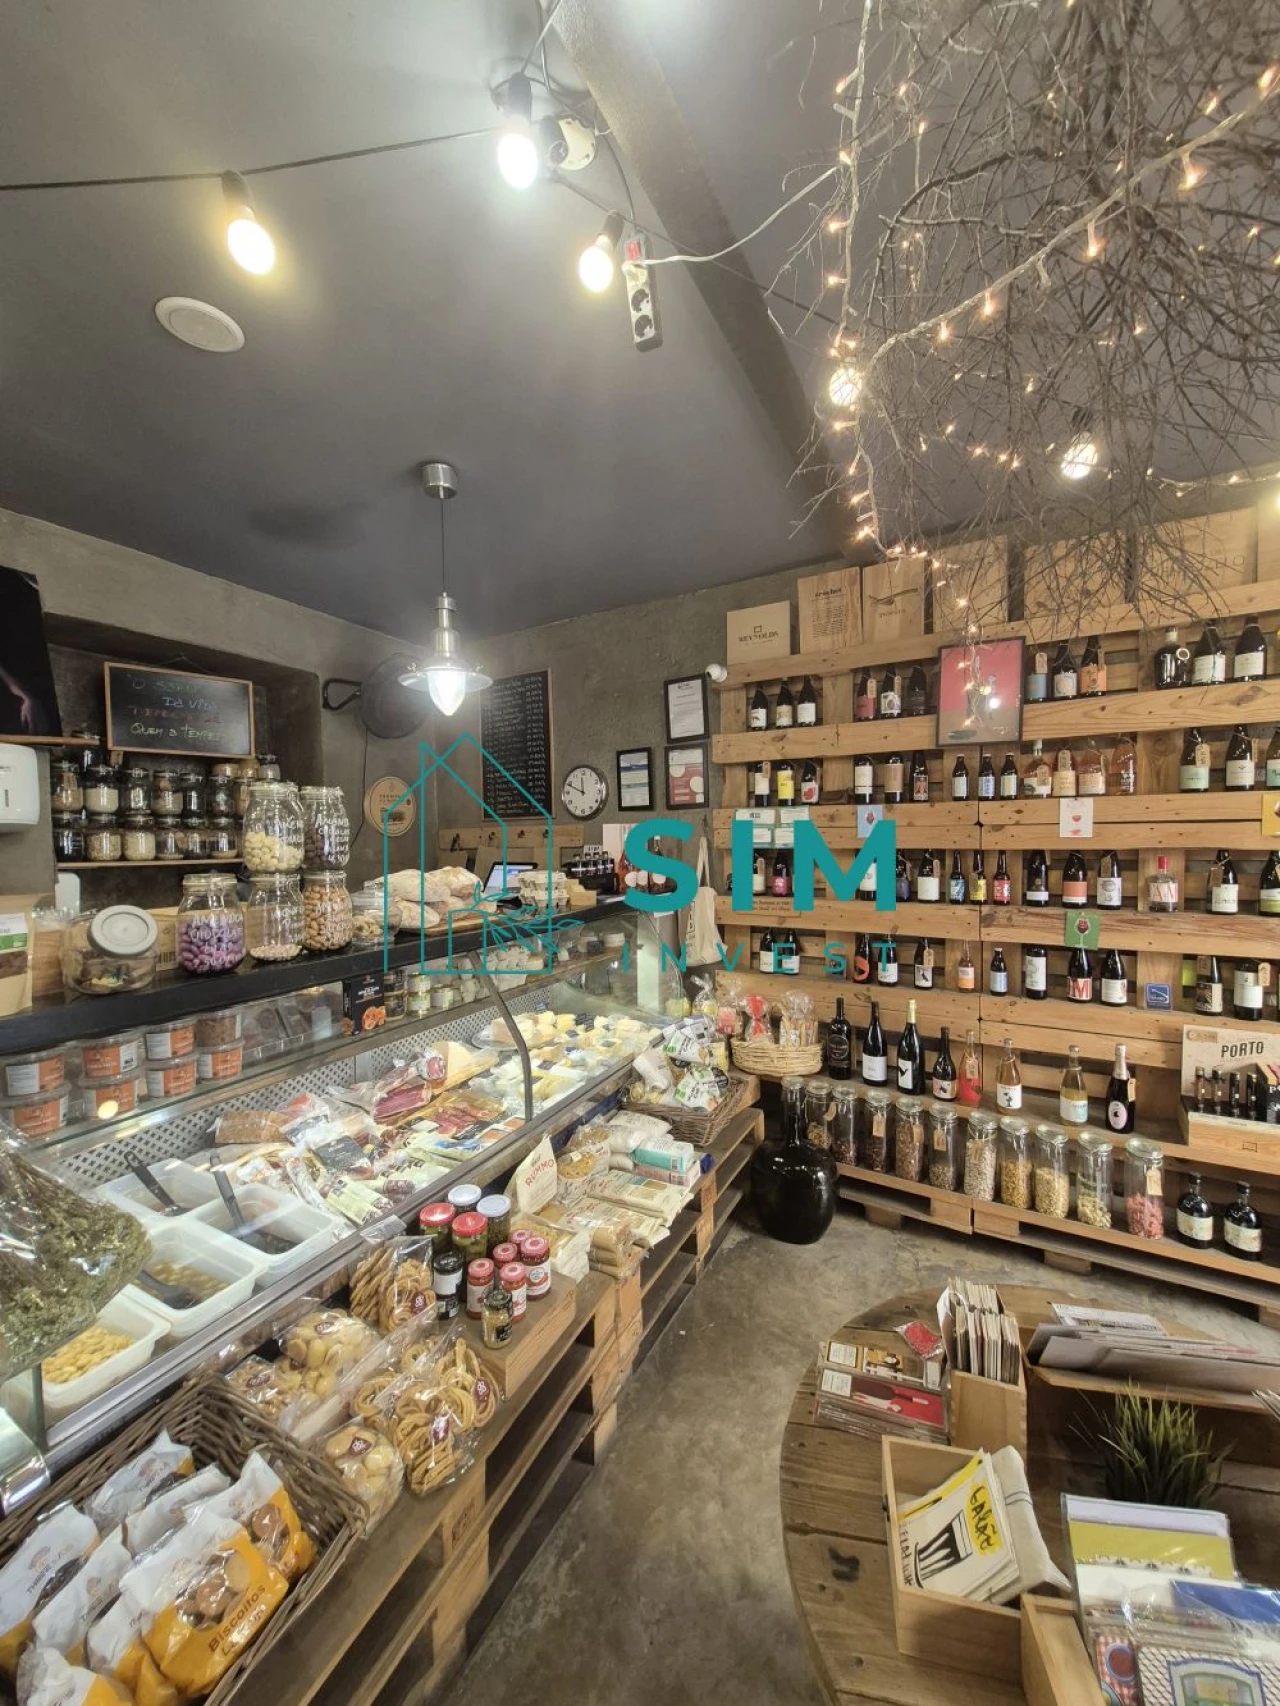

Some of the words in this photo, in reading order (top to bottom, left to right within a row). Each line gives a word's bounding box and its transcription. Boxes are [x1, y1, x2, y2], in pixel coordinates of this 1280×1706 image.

[1220, 1041, 1264, 1058] PORTO
[525, 1158, 555, 1187] RUMMO
[209, 1585, 266, 1652] Biscoitos
